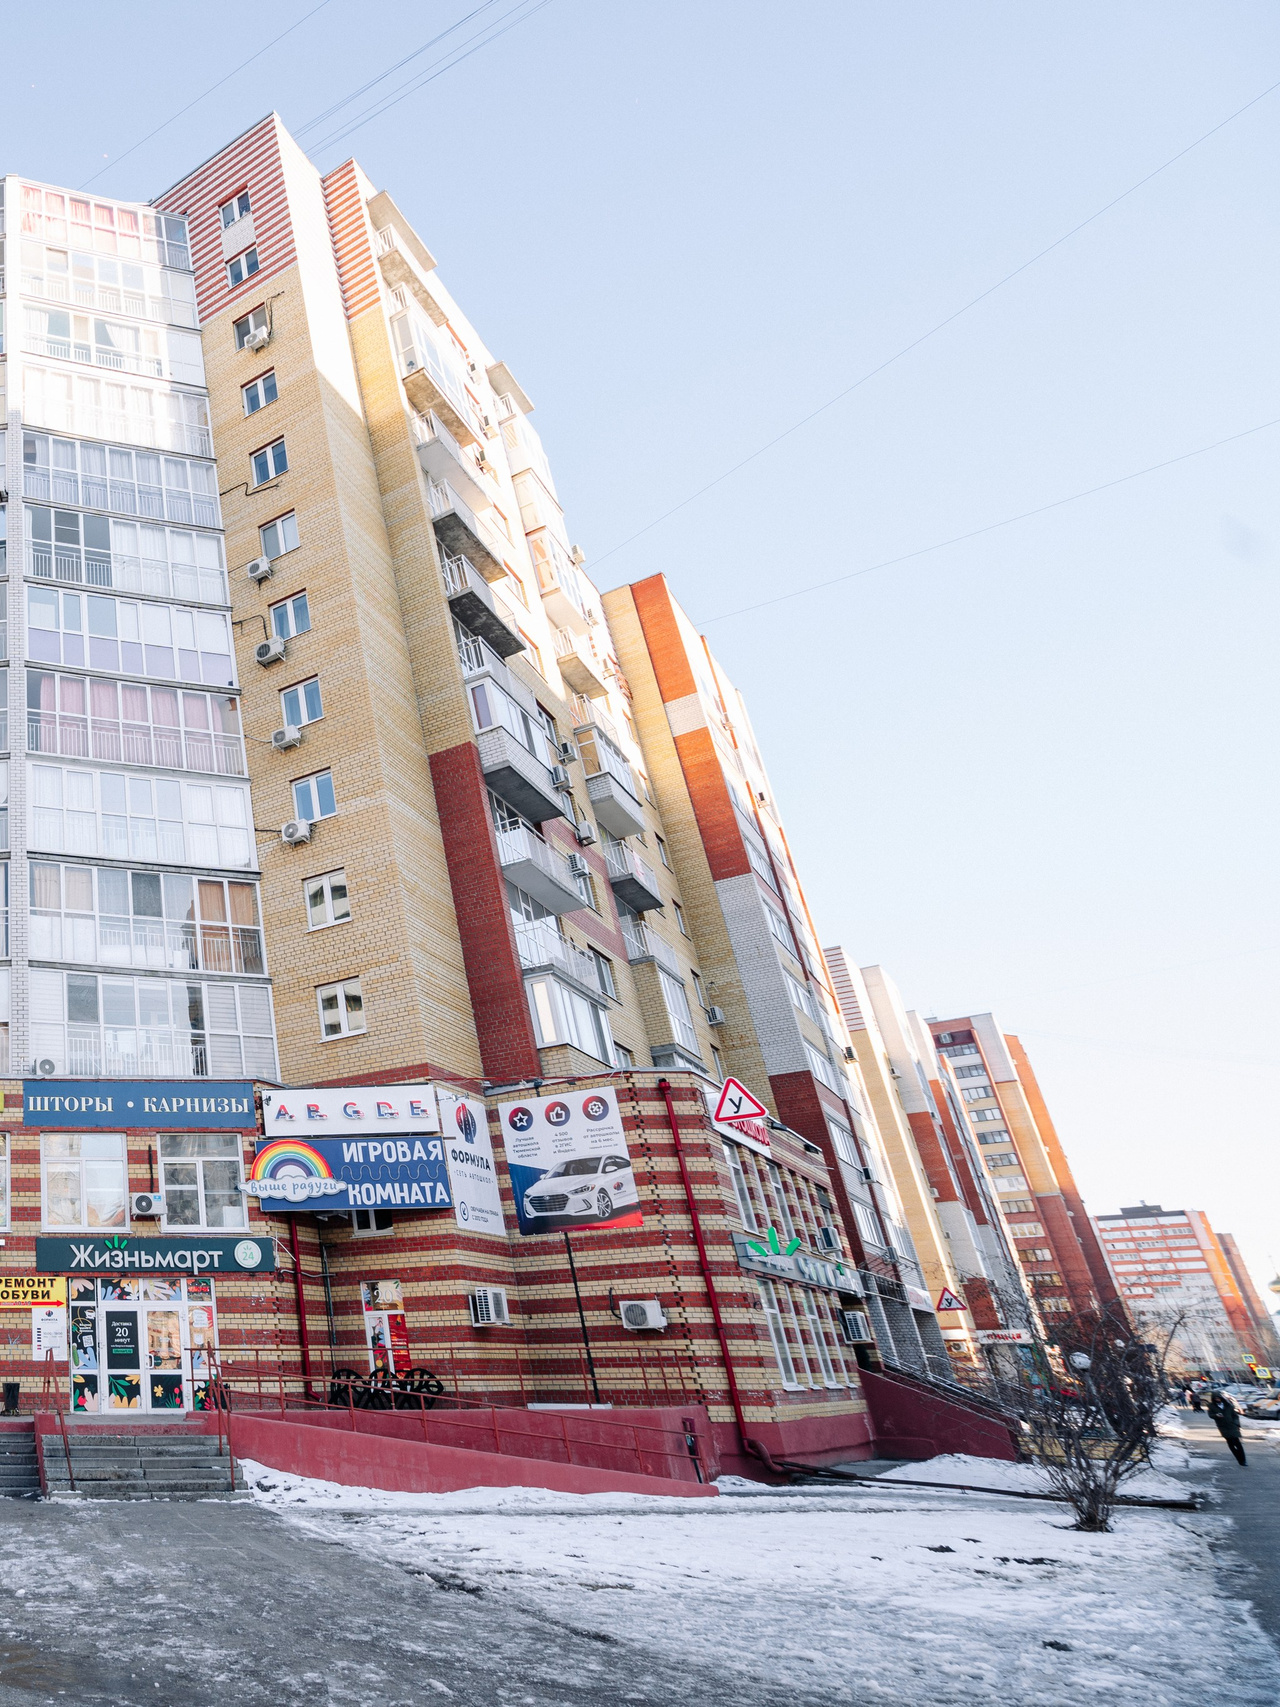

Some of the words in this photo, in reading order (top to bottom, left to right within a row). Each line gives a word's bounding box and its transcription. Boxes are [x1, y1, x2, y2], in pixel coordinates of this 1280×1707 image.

[28, 1096, 114, 1112] ШТОРЫ
[143, 1097, 249, 1114] КАРНИЗЫ
[728, 1097, 742, 1114] У
[342, 1140, 444, 1163] ИГРОВАЯ
[451, 1148, 491, 1171] ФОРМУЛА
[250, 1181, 287, 1194] выше
[293, 1181, 338, 1194] радуги
[347, 1182, 450, 1206] КОМНАТА
[69, 1244, 223, 1275] Жизньмарт
[243, 1252, 254, 1260] 24
[0, 1290, 50, 1300] ОБУВИ
[374, 1290, 393, 1303] 20
[116, 1328, 128, 1337] 20
